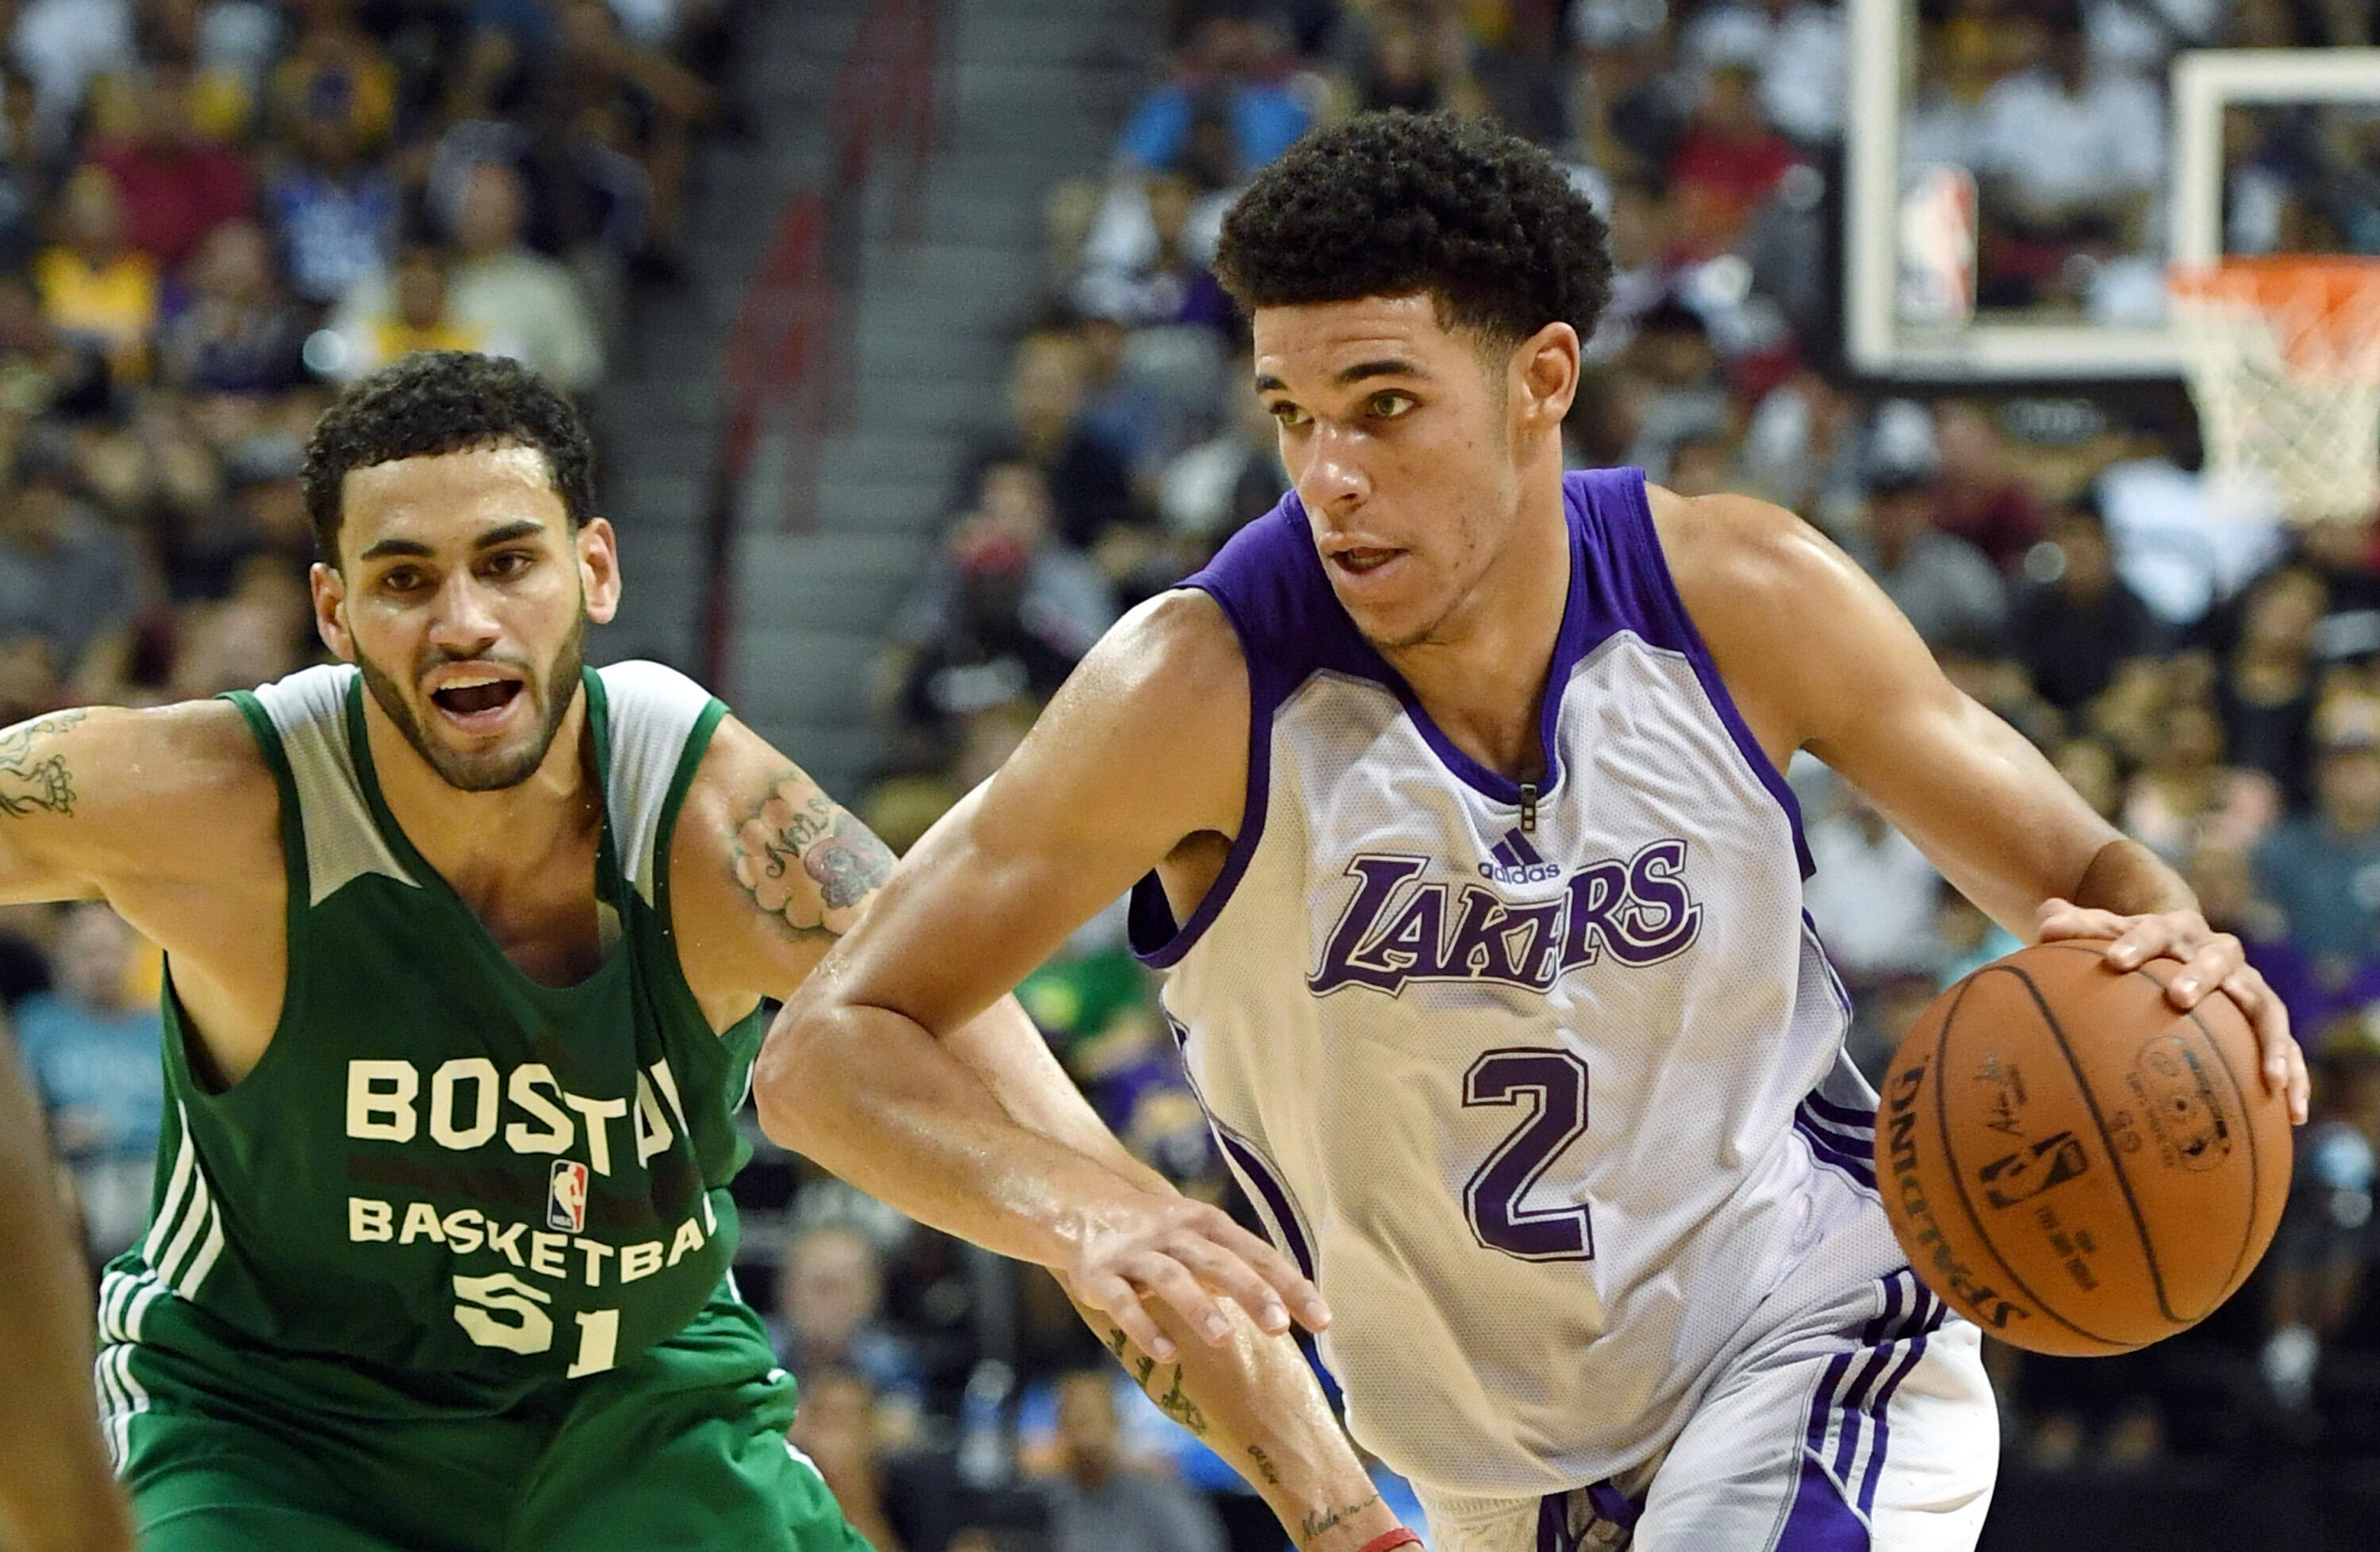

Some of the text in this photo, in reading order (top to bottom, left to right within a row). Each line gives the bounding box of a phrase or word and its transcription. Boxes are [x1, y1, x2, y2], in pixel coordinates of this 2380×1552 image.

[1305, 838, 1703, 1000] LAKERS
[1477, 863, 1561, 885] adidas
[1462, 1047, 1595, 1262] 2
[1889, 1064, 2029, 1328] SPALDING
[452, 1272, 620, 1379] 51
